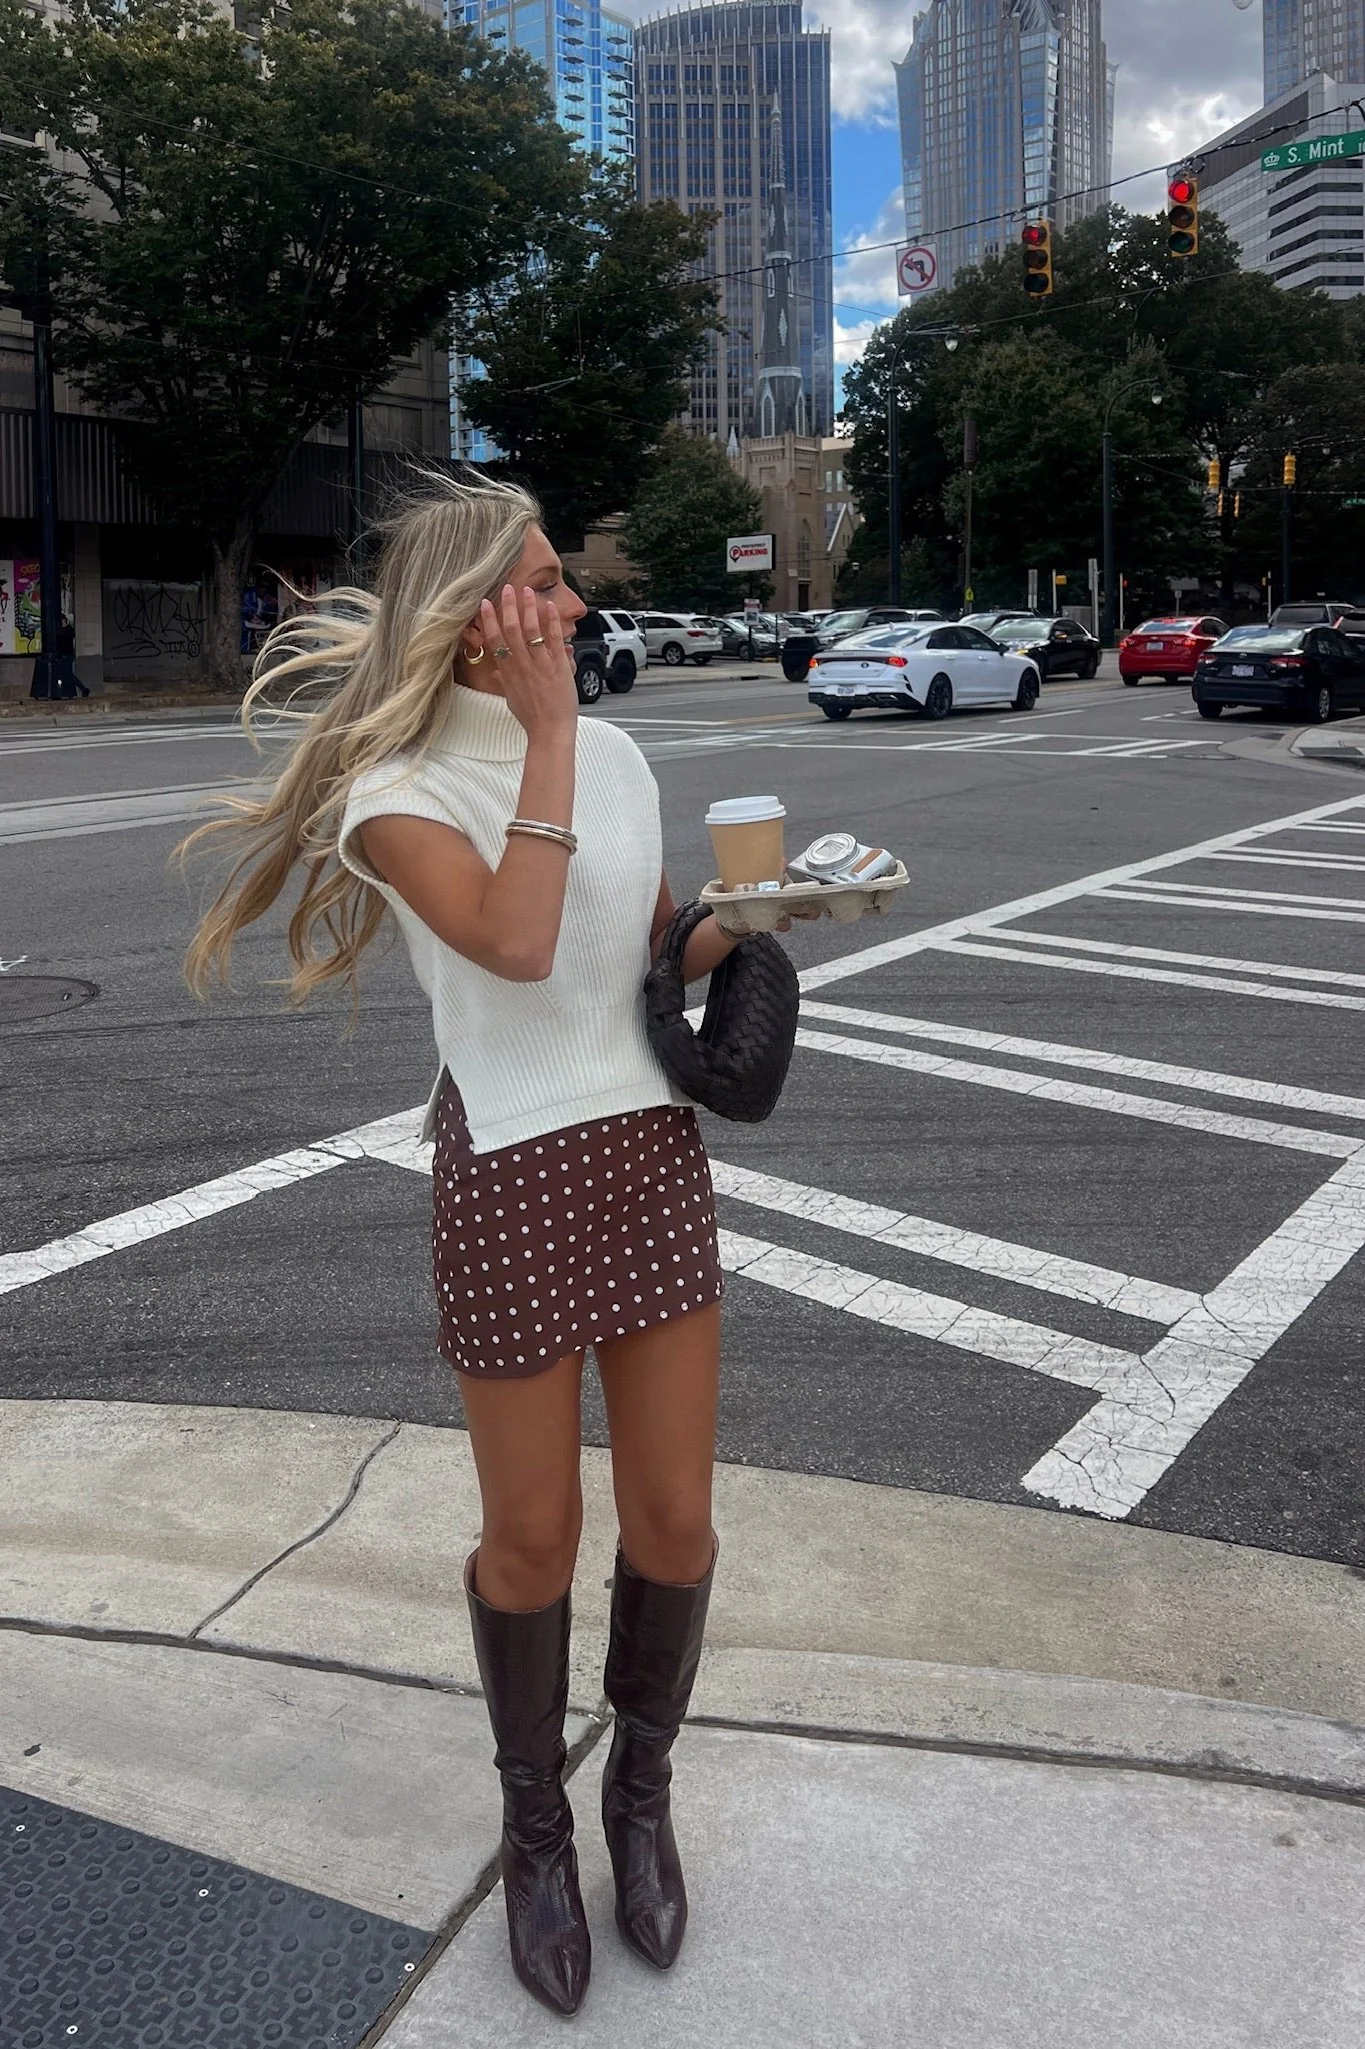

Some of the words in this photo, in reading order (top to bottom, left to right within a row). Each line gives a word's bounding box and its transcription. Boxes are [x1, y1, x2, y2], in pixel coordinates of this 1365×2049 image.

[746, 0, 771, 8] THIRD
[1287, 147, 1302, 163] S.
[1309, 138, 1344, 160] Mint
[732, 548, 768, 557] PARKING
